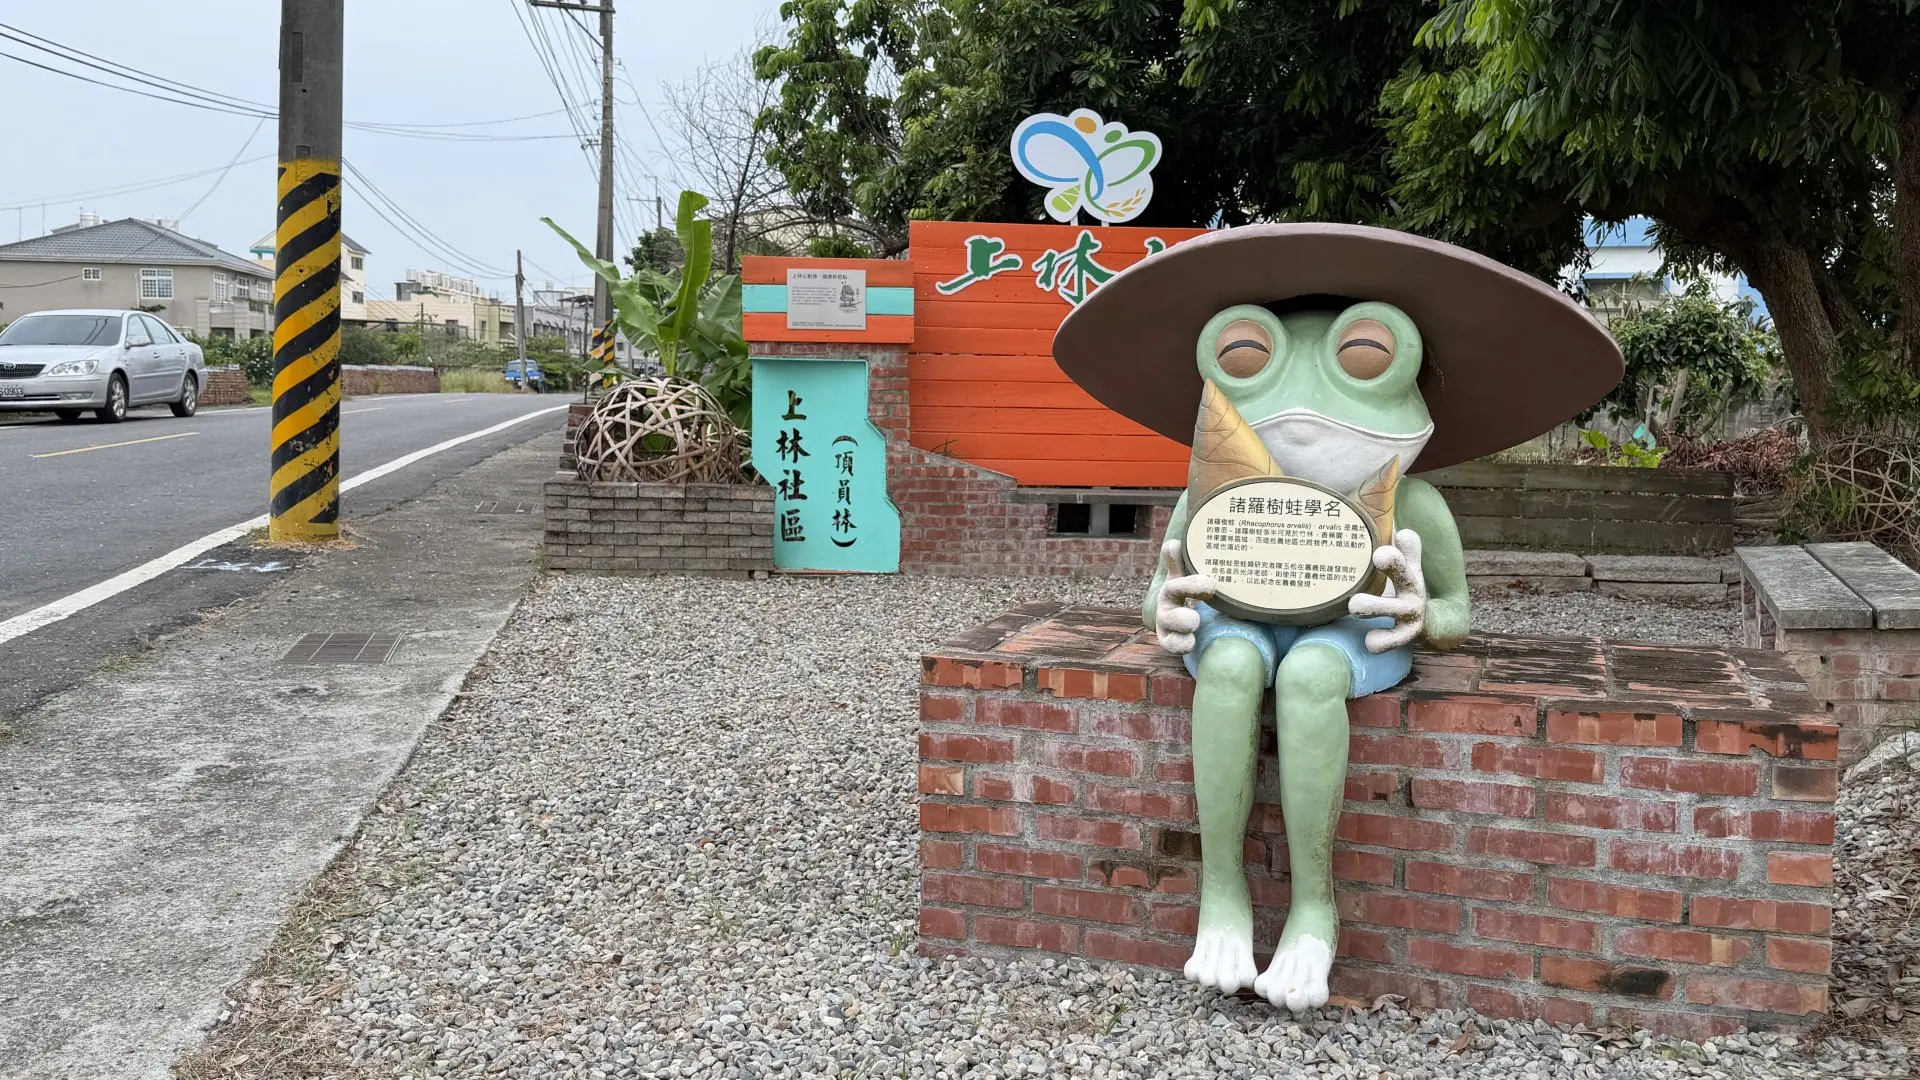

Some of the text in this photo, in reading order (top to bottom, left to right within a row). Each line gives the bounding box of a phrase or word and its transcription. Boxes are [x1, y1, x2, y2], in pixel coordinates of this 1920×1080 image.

[935, 229, 1175, 306] 上林
[776, 390, 811, 542] 上林社區
[1207, 518, 1235, 526] 諸羅樹蛙
[1238, 519, 1285, 528] (Rhacophorus
[1318, 523, 1342, 531] arvalis
[1229, 496, 1341, 517] 諸羅樹蛙學名
